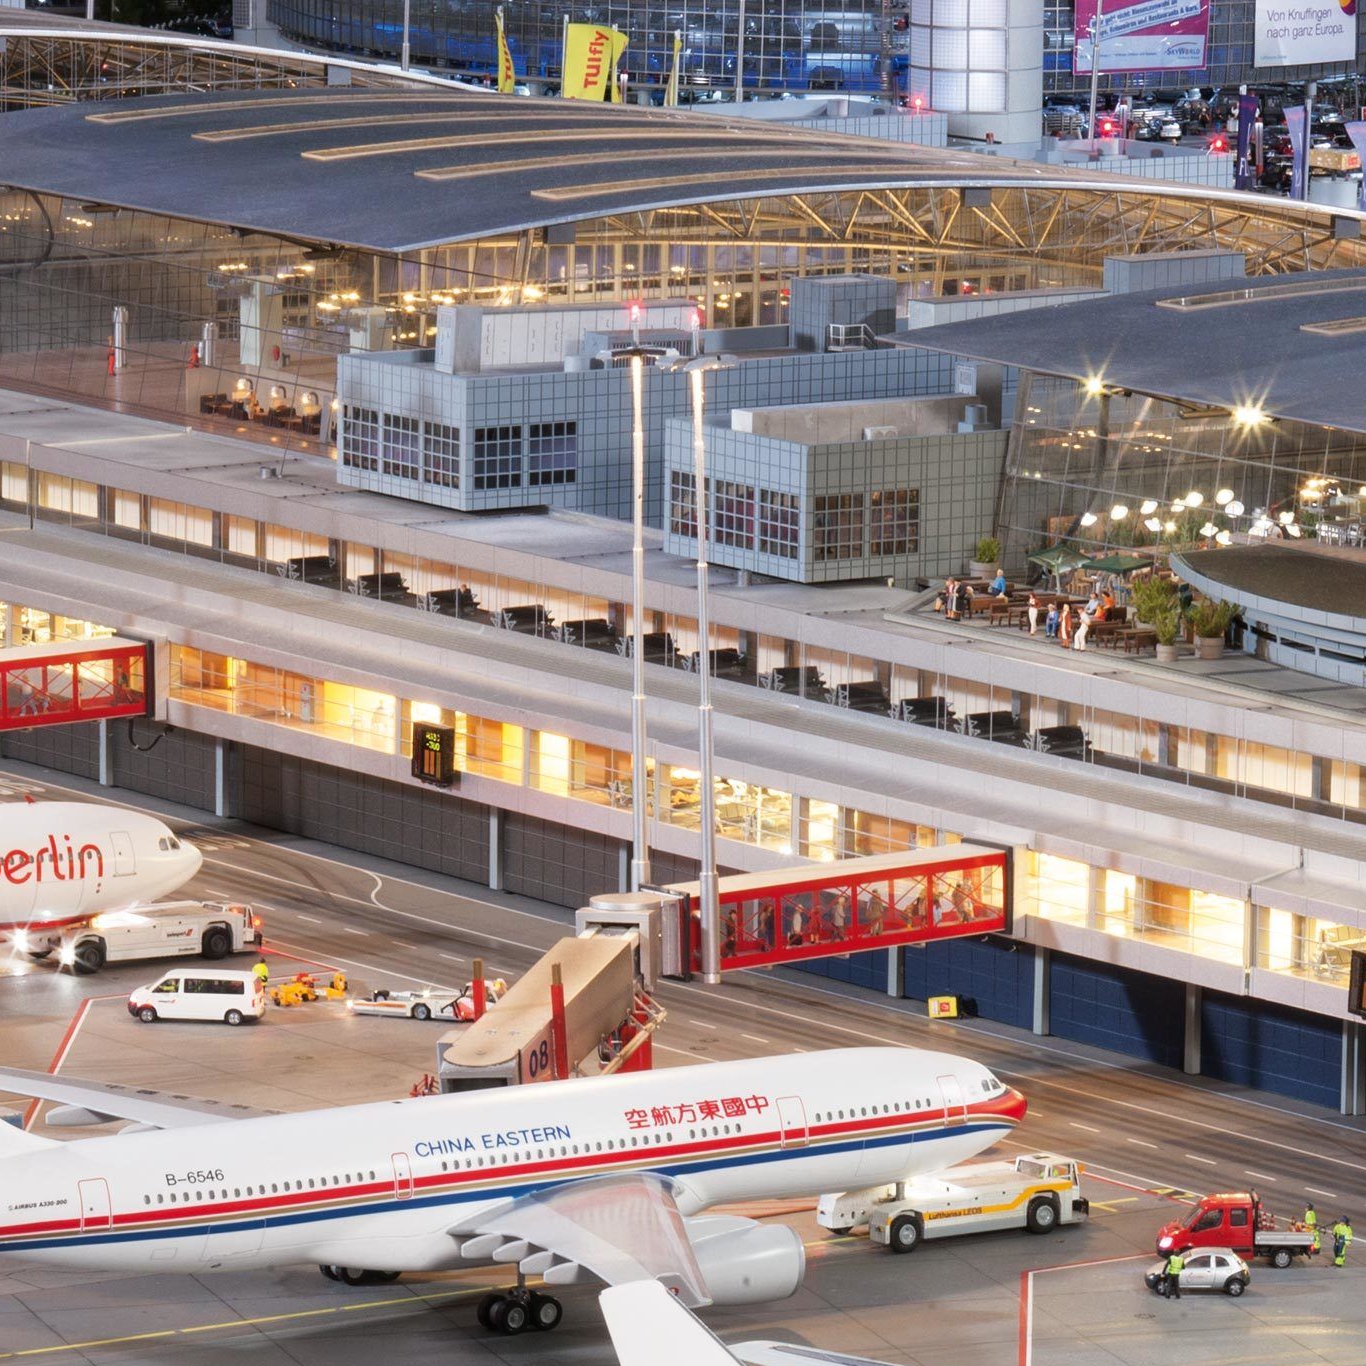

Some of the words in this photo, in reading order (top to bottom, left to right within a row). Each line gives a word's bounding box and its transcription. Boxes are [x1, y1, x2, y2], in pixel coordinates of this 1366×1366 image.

[1267, 9, 1285, 22] Von
[1288, 7, 1332, 22] Knuffingen
[1266, 26, 1290, 39] nach
[1292, 26, 1313, 40] ganz
[1315, 23, 1344, 37] Europa.
[584, 30, 609, 88] TUIfly
[529, 1039, 549, 1078] 08
[415, 1136, 476, 1158] CHINA
[483, 1125, 572, 1150] EASTERN
[165, 1169, 225, 1186] B-6546
